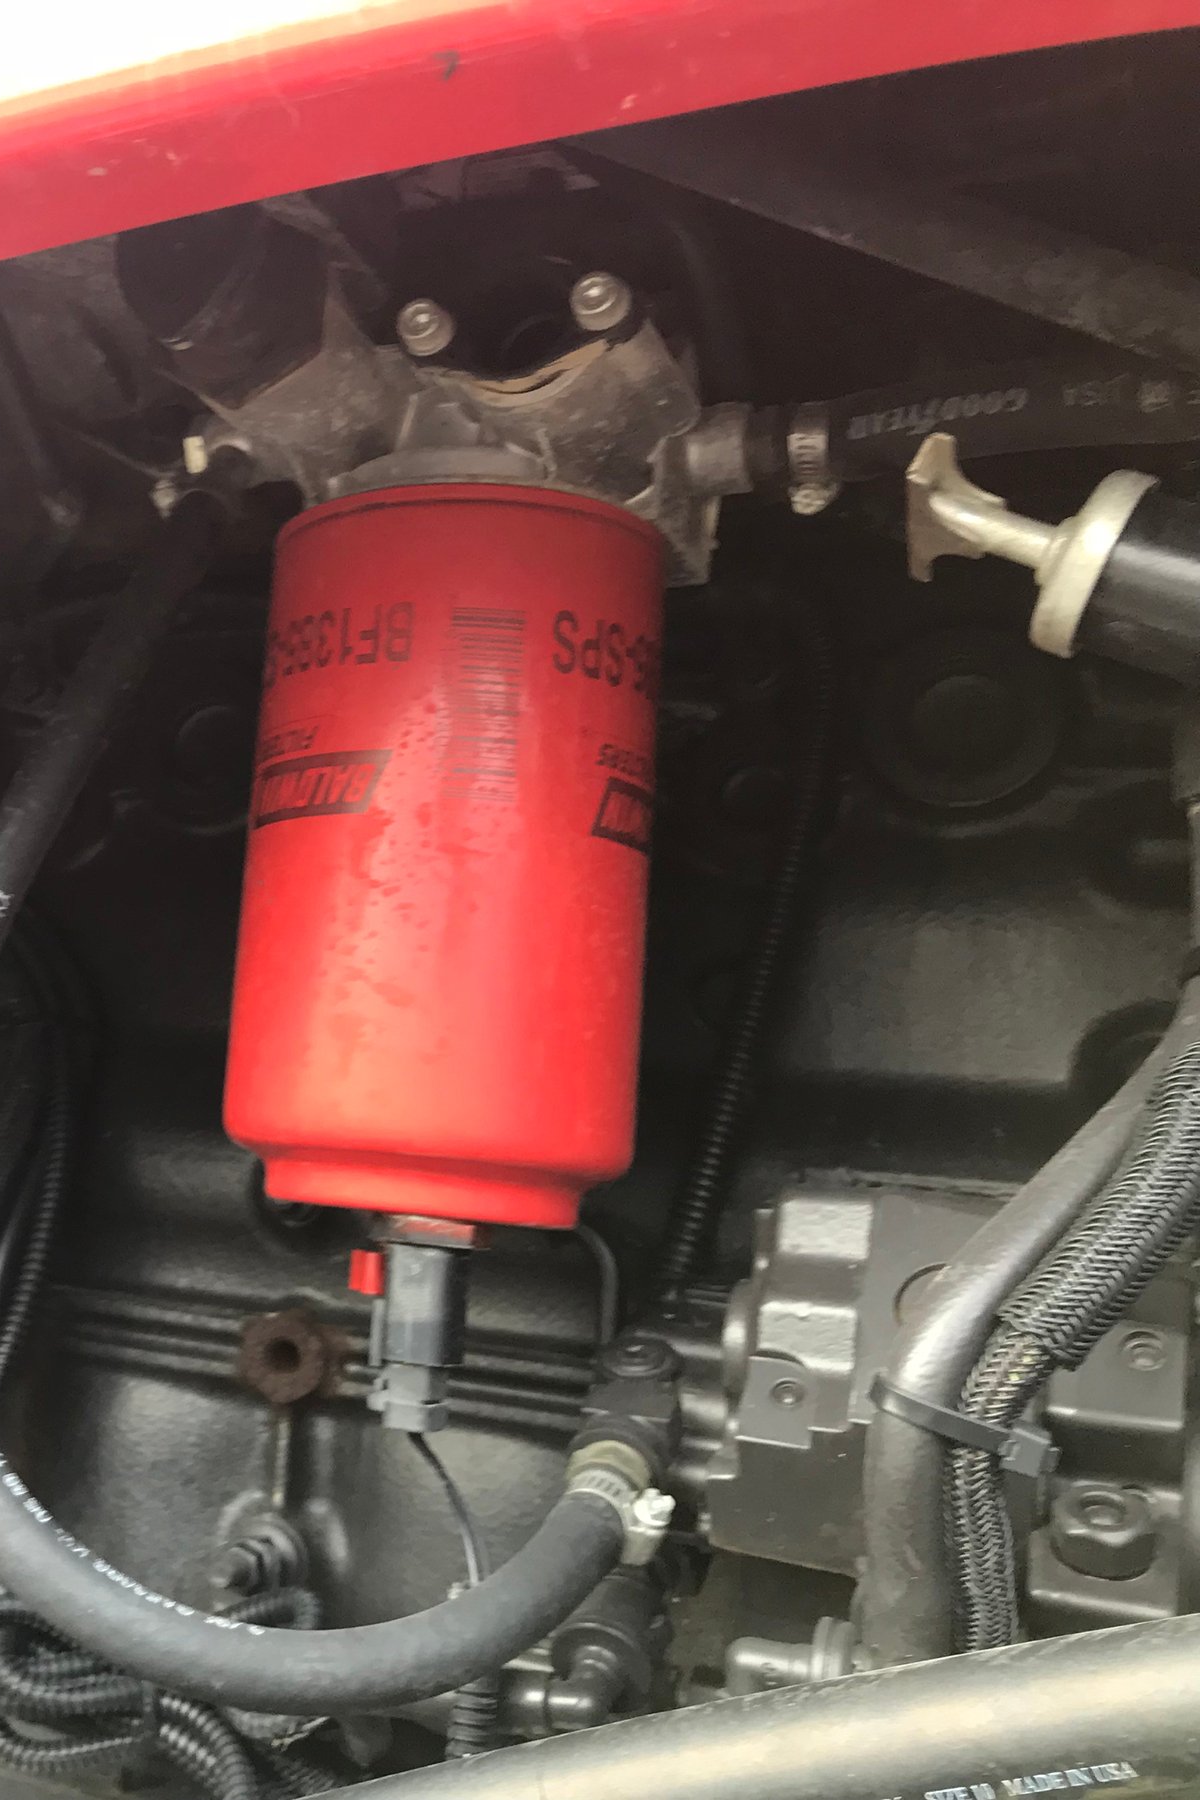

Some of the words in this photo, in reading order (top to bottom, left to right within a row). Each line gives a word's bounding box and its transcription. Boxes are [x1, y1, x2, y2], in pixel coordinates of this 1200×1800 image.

[1001, 1771, 1070, 1797] MADE
[1065, 1767, 1094, 1787] IN
[1090, 1761, 1140, 1783] USA
